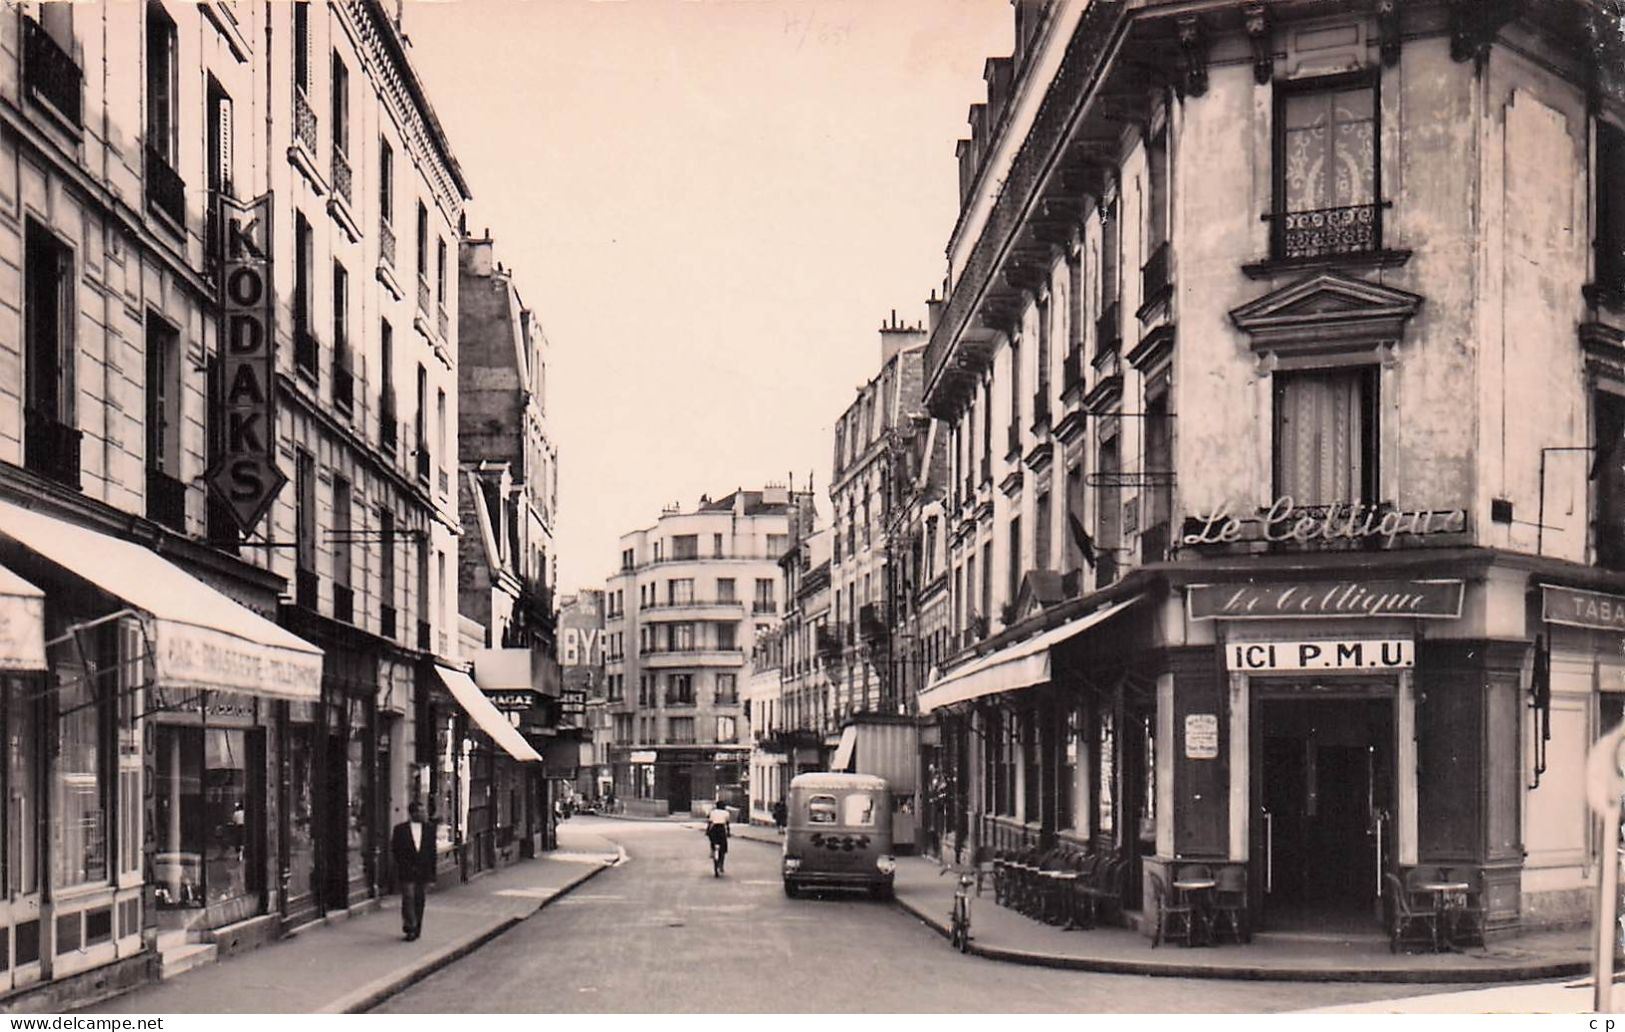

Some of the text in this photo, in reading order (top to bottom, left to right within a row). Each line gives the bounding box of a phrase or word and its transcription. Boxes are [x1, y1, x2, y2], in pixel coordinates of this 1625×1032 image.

[227, 217, 265, 502] KODAKS
[1184, 501, 1241, 543] Le
[1258, 496, 1464, 549] Celtique
[1236, 643, 1412, 668] ICI P.M.U.
